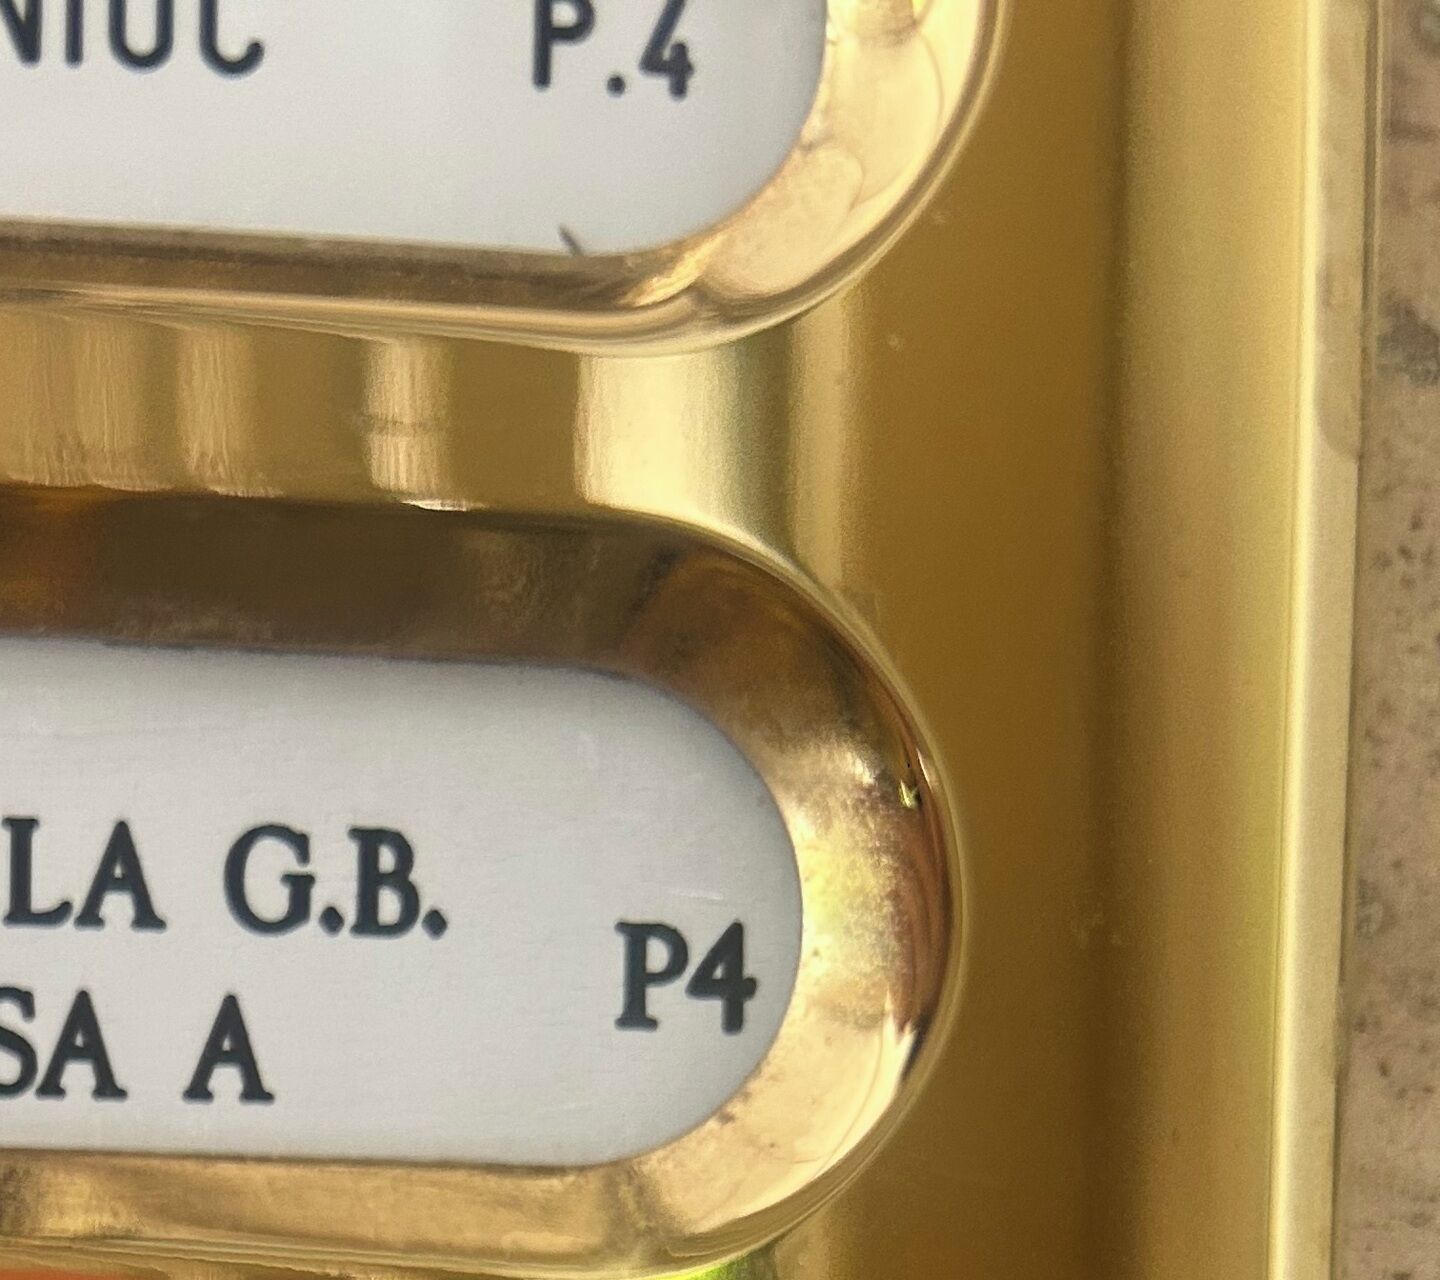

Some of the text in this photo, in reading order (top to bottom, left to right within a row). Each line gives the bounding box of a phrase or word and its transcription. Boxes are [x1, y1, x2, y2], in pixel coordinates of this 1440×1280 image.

[534, 0, 694, 98] P.4
[223, 823, 449, 938] G.B.
[615, 920, 759, 1035] P4
[182, 993, 275, 1103] A
